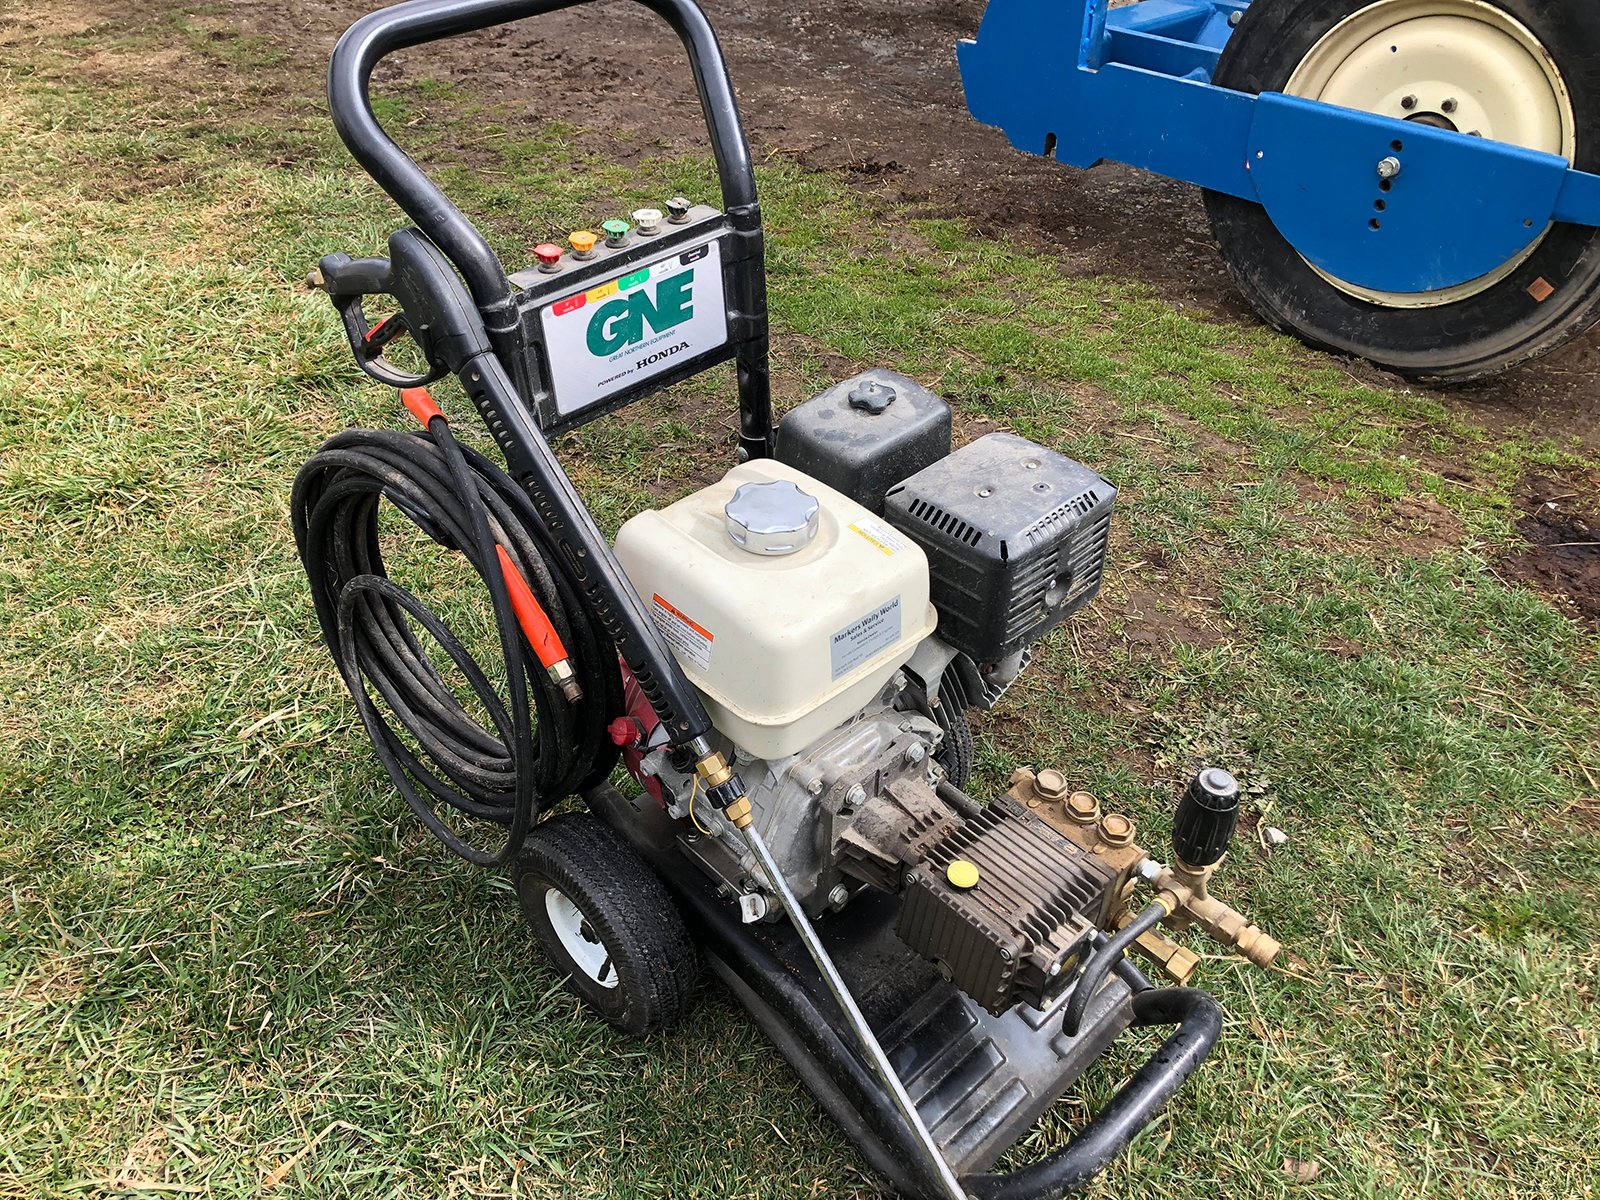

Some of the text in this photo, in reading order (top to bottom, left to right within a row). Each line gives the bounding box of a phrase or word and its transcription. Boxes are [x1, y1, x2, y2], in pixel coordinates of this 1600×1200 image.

[586, 268, 695, 357] GNE
[597, 371, 627, 388] POWERED
[635, 341, 691, 371] HONDA
[608, 329, 677, 363] GREAT NORTHERN EQUIPMENT
[834, 622, 862, 644] Markers
[861, 611, 880, 628] Wally
[879, 599, 899, 616] World
[850, 631, 863, 642] Sales
[867, 618, 885, 631] Service
